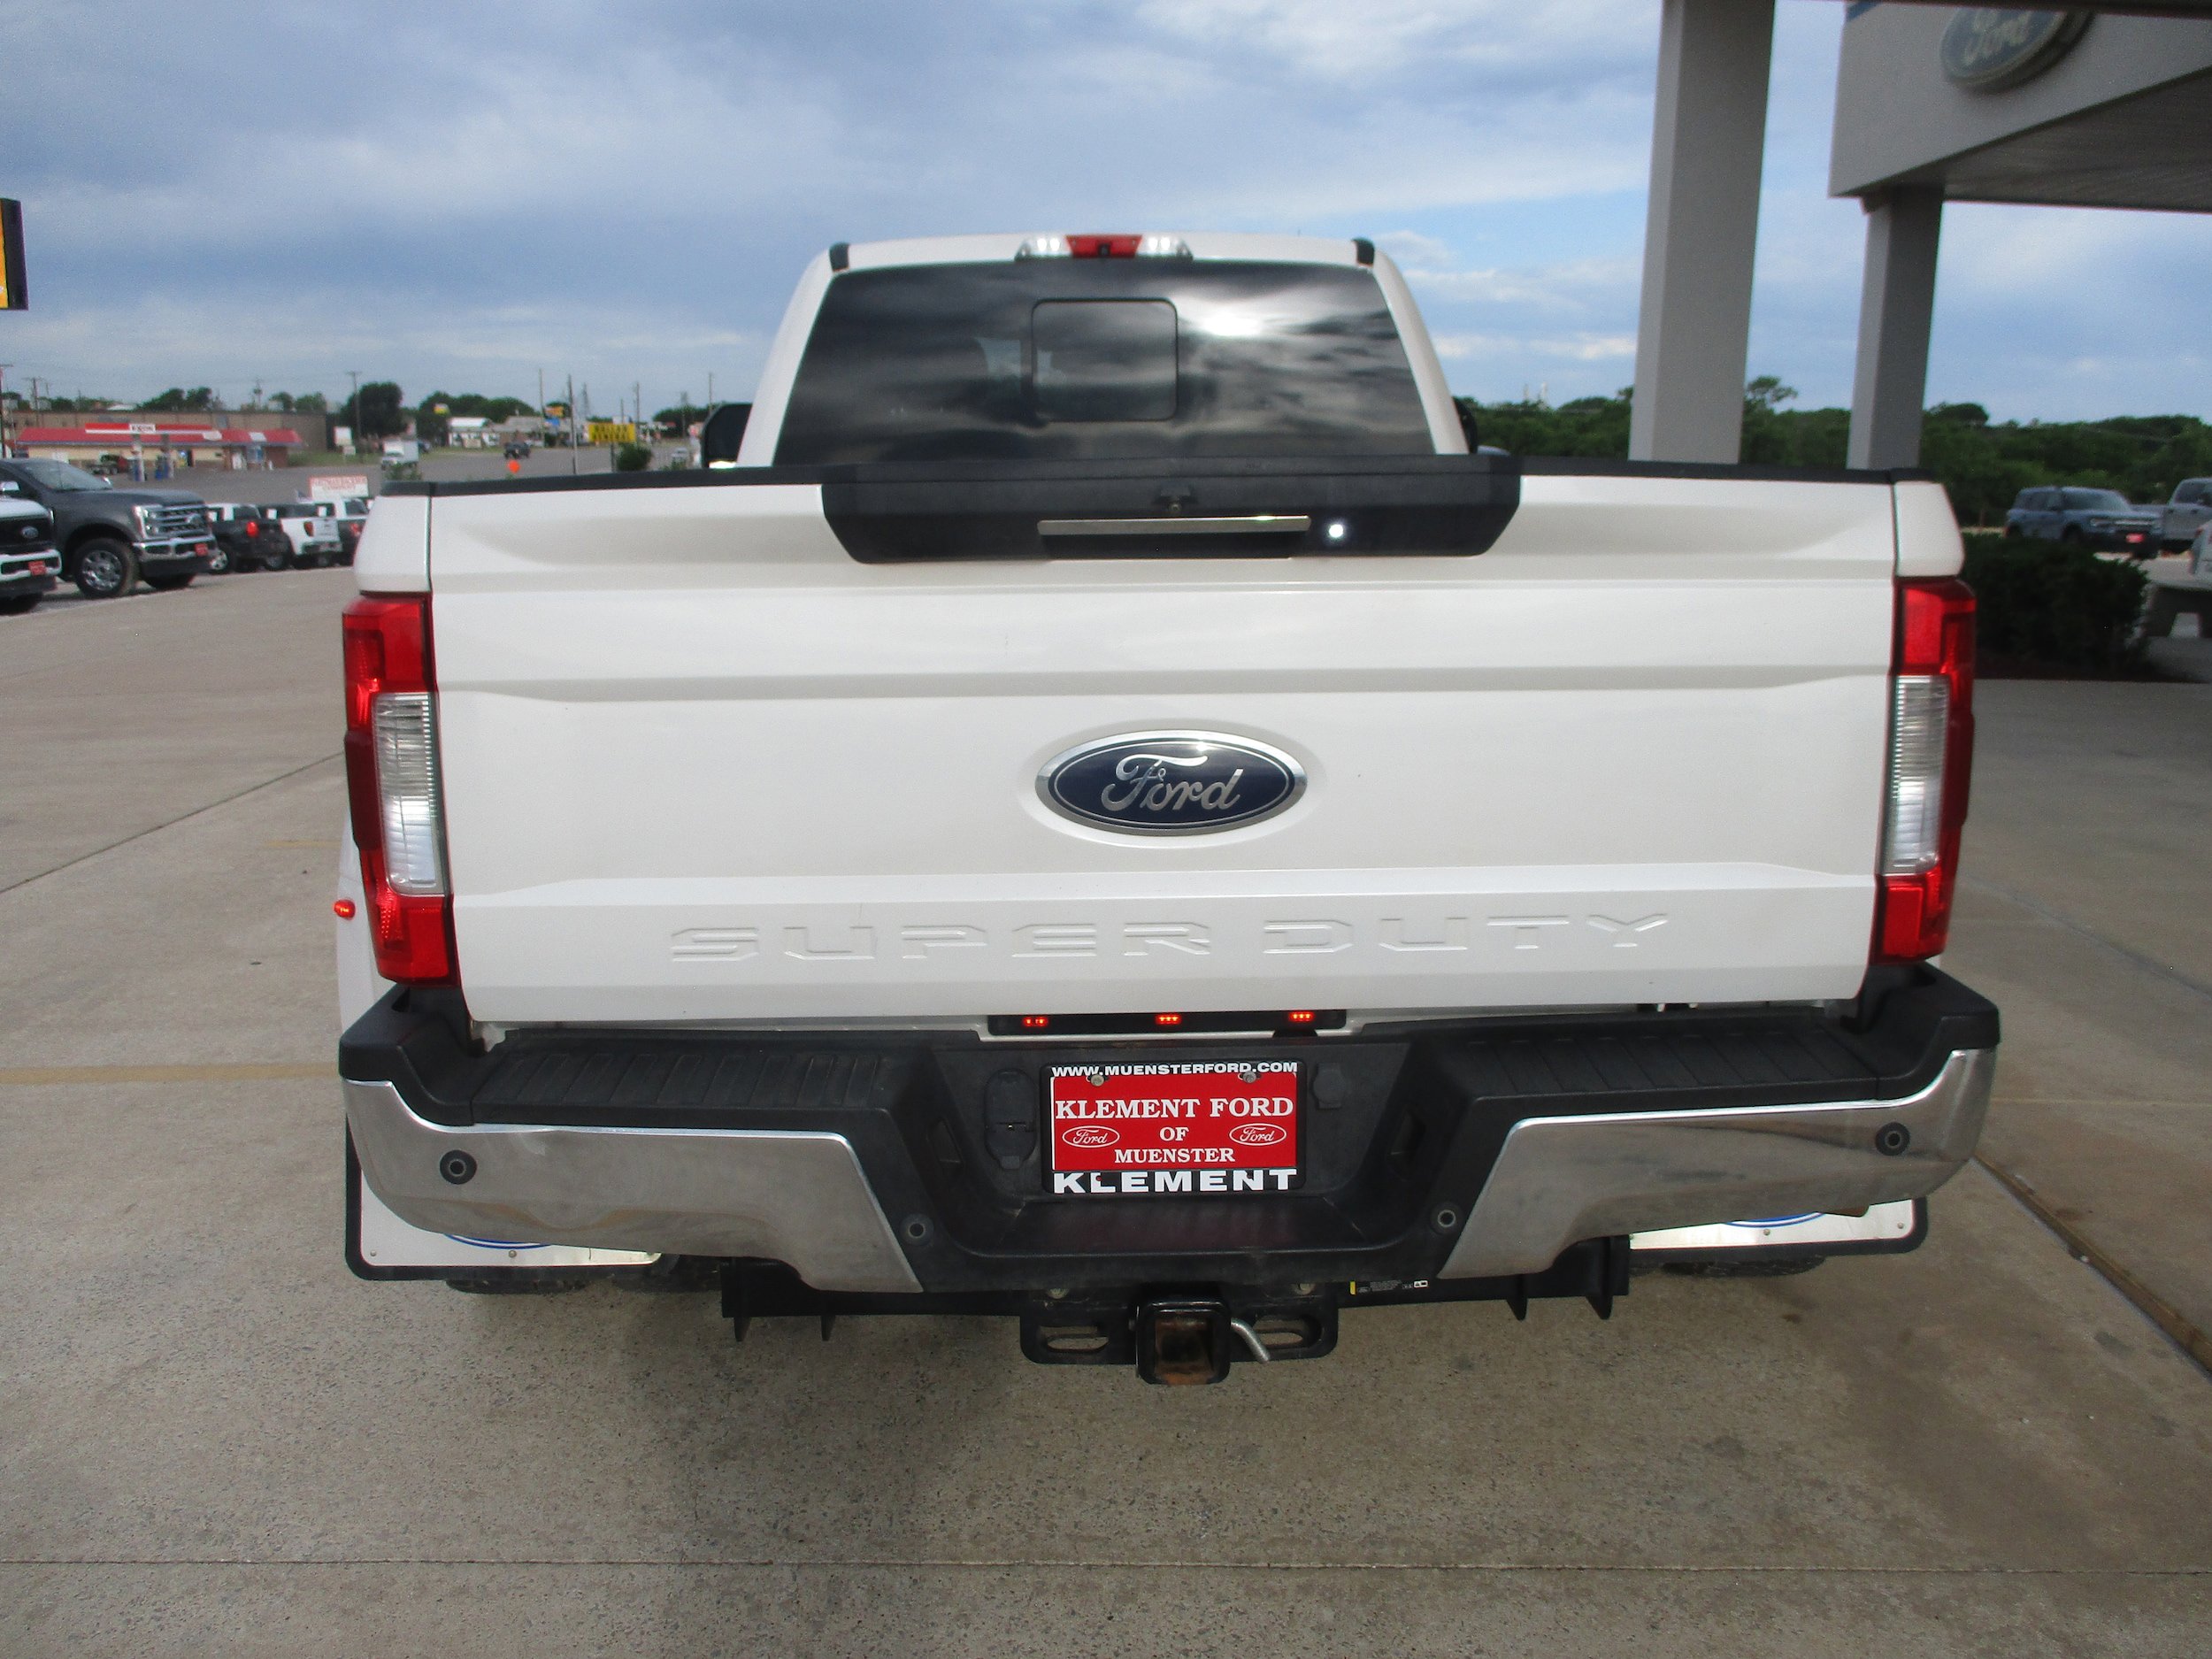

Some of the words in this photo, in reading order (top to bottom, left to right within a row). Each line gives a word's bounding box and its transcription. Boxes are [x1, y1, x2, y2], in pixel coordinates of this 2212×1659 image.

[1101, 753, 1244, 812] Ford
[670, 922, 1210, 963] SUPER
[1263, 913, 1671, 956] DUTY
[1052, 1062, 1298, 1077] WWW.MUENSTERFORD.COM
[1055, 1098, 1201, 1119] KLEMENT
[1210, 1096, 1294, 1118] FORD
[1071, 1129, 1109, 1146] Ford
[1159, 1127, 1189, 1142] OF
[1239, 1127, 1276, 1143] Ford
[1114, 1148, 1236, 1164] MUENSTER
[1053, 1168, 1298, 1194] KLEMENT
